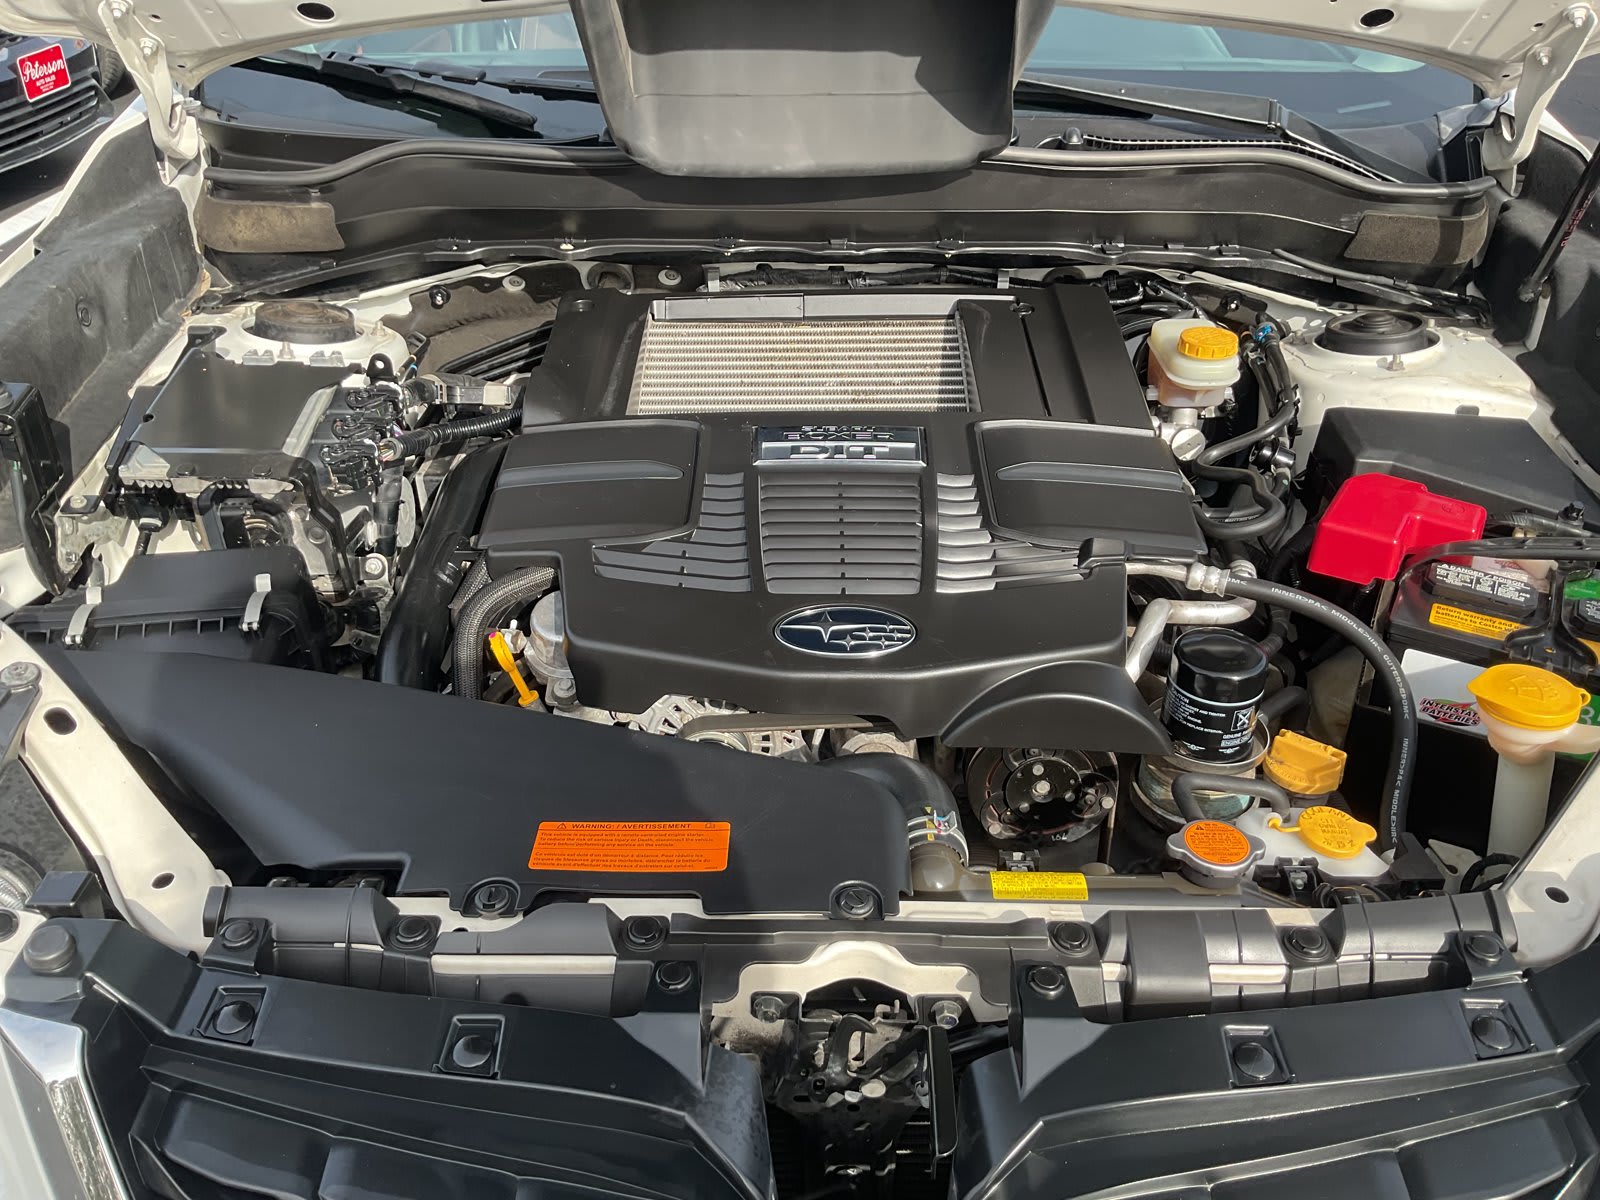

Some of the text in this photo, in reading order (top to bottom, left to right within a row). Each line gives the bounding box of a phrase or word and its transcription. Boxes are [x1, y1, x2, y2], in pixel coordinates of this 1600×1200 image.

[22, 58, 64, 82] Peterson
[784, 432, 894, 440] BOXER
[790, 445, 889, 459] DIT
[1448, 565, 1484, 578] DANGER
[1493, 576, 1524, 587] POISON
[1436, 605, 1462, 615] Return
[1463, 612, 1496, 624] warranty
[1436, 610, 1468, 622] batteries
[1479, 621, 1502, 630] Costco
[1422, 706, 1478, 725] BATTERIES
